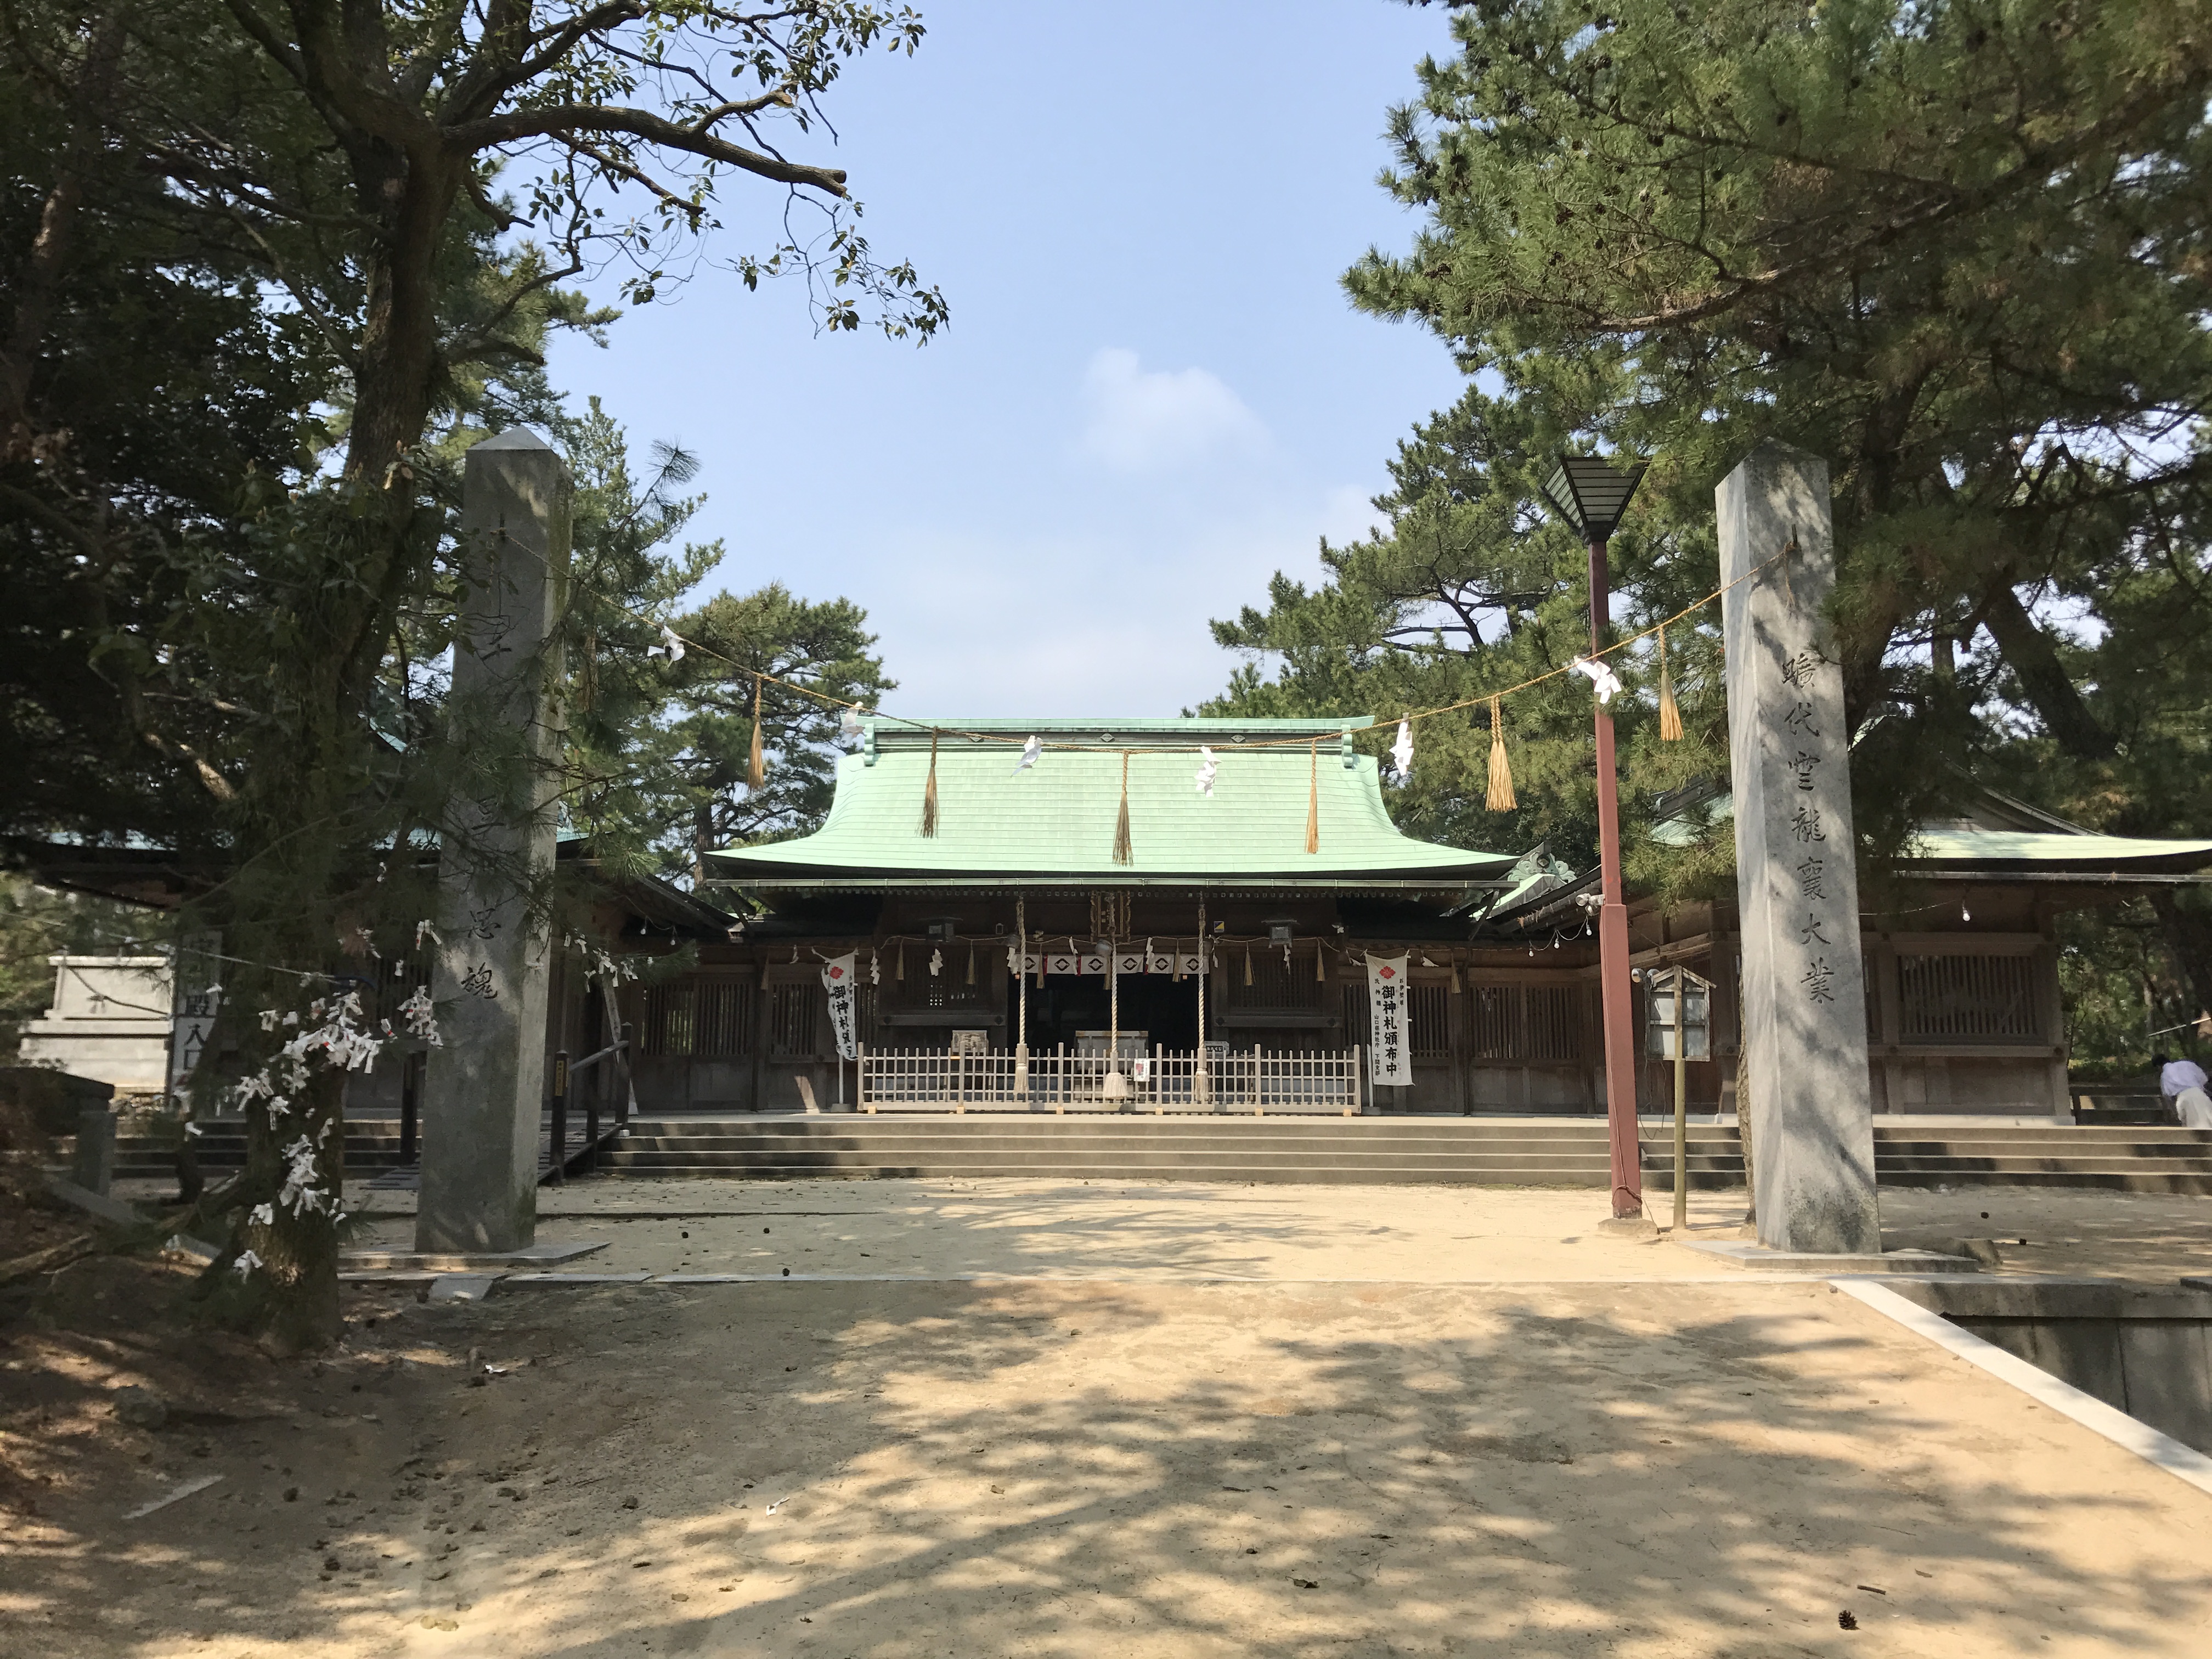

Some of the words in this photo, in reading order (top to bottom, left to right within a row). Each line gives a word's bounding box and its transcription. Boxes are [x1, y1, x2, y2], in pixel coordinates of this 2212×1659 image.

[1381, 985, 1397, 1077] 御神札頒布中
